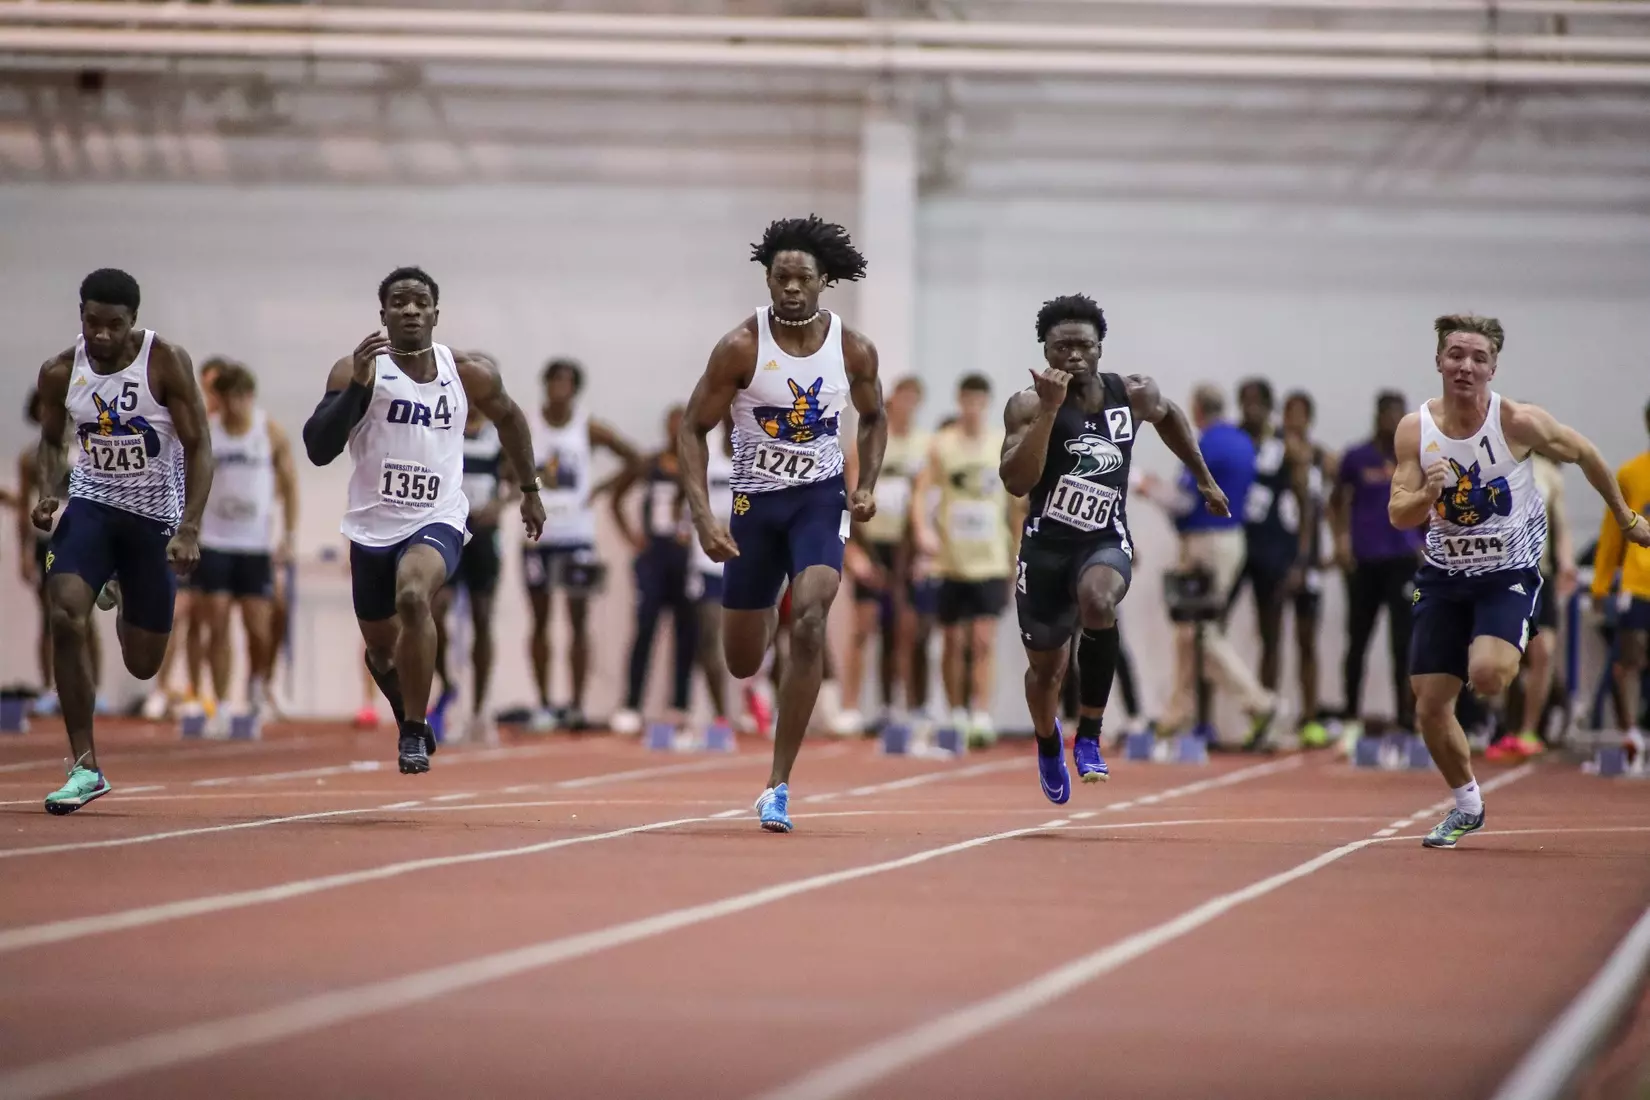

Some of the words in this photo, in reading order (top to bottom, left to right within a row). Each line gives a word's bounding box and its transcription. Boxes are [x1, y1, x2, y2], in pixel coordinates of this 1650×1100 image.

[120, 381, 139, 411] 5
[434, 395, 451, 424] 4
[1110, 410, 1130, 439] 2
[91, 446, 145, 471] 1243
[756, 449, 814, 479] 1242
[1479, 435, 1496, 465] 1
[384, 463, 412, 471] UNIVERSITY
[382, 471, 440, 500] 1359
[1062, 478, 1089, 491] UNIVERSITY
[1096, 489, 1114, 499] KANSAS
[1053, 486, 1110, 524] 1036
[1444, 537, 1503, 557] 1244
